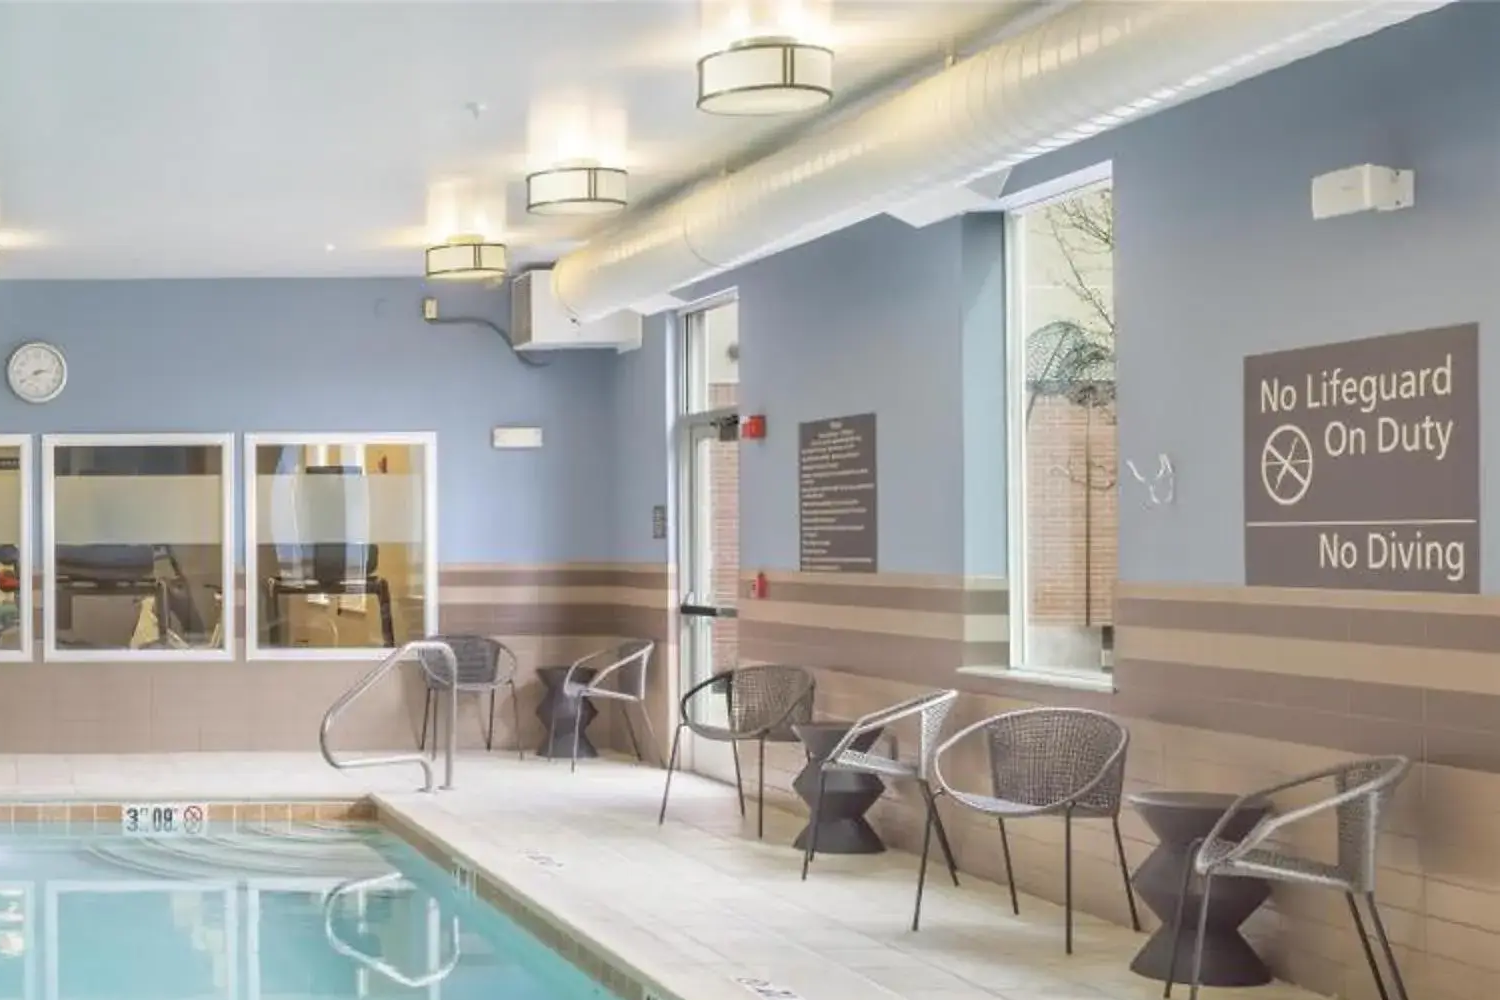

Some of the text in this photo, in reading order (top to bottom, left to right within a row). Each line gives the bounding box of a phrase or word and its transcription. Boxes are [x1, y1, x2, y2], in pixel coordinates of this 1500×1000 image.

[1261, 353, 1452, 413] No Lifeguard
[1324, 415, 1454, 460] On Duty
[1319, 530, 1465, 581] No Diving
